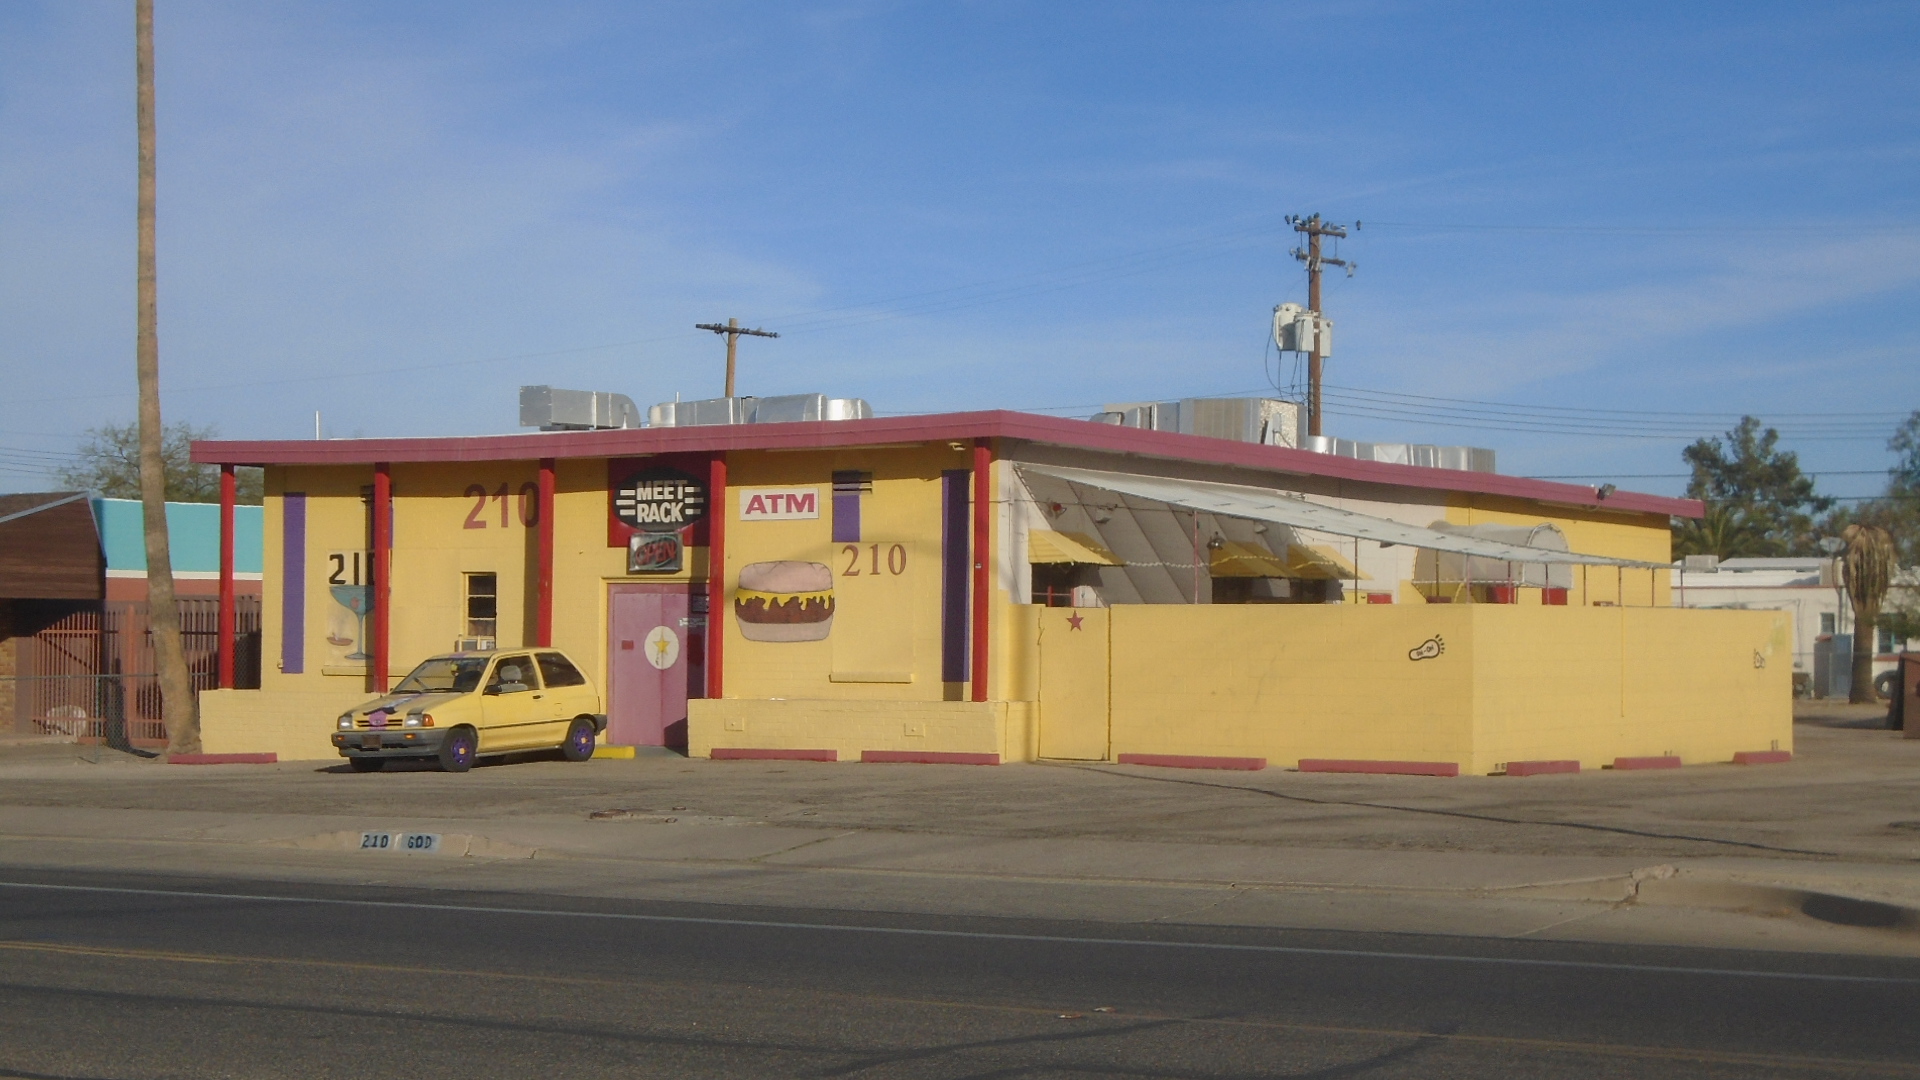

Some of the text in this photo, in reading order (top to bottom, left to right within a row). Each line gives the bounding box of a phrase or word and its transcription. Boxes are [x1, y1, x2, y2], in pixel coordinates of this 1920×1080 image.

[636, 479, 688, 500] MEET
[463, 481, 540, 529] 210
[636, 501, 684, 523] RACK
[744, 493, 815, 514] ATM
[635, 540, 677, 566] OPEN
[841, 543, 907, 576] 210
[361, 835, 432, 849] 210 GOD
